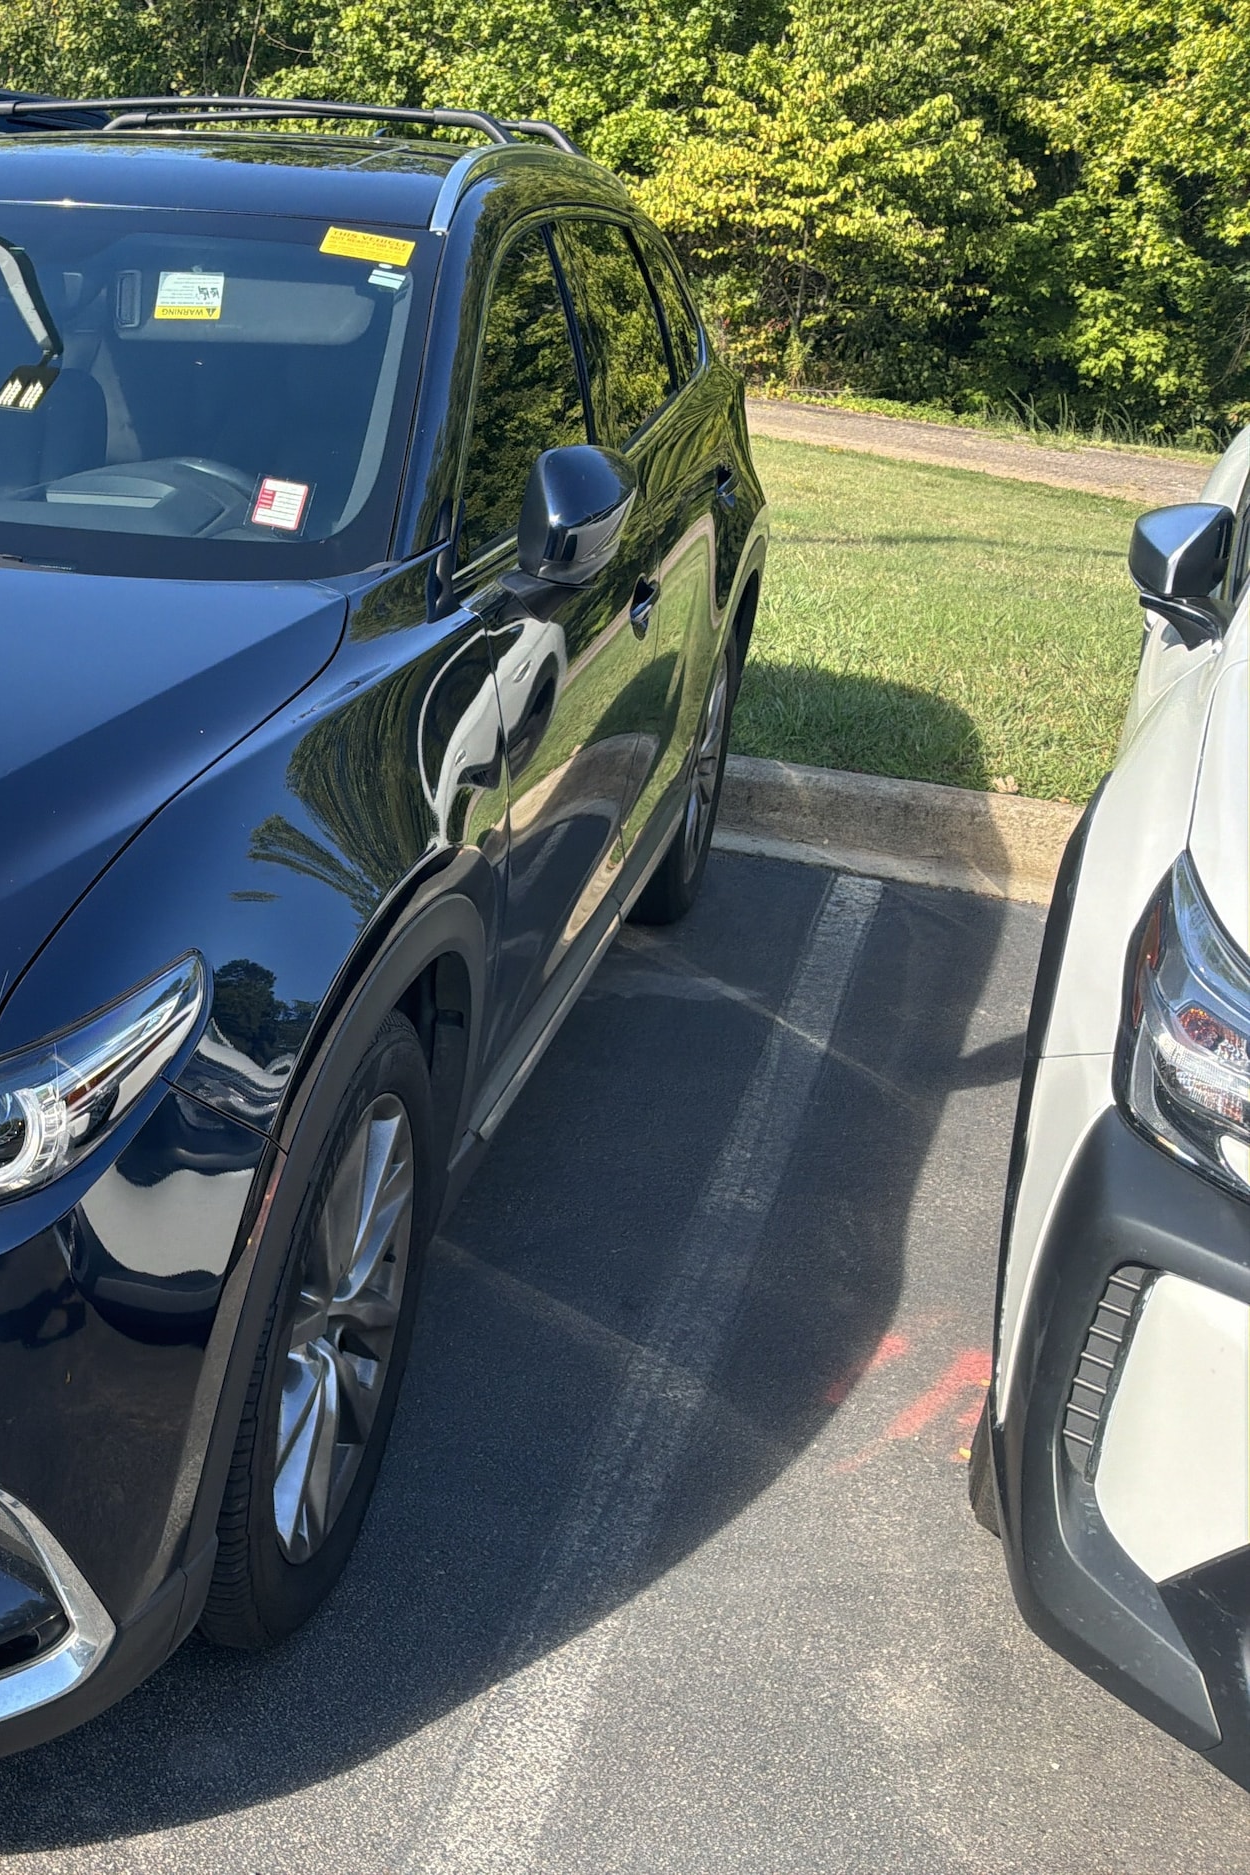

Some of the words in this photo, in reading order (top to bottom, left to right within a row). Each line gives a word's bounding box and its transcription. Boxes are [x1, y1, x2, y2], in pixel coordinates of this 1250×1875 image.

[333, 230, 358, 239] THIS
[362, 234, 408, 248] VEHICLE
[161, 308, 204, 316] WARNING
